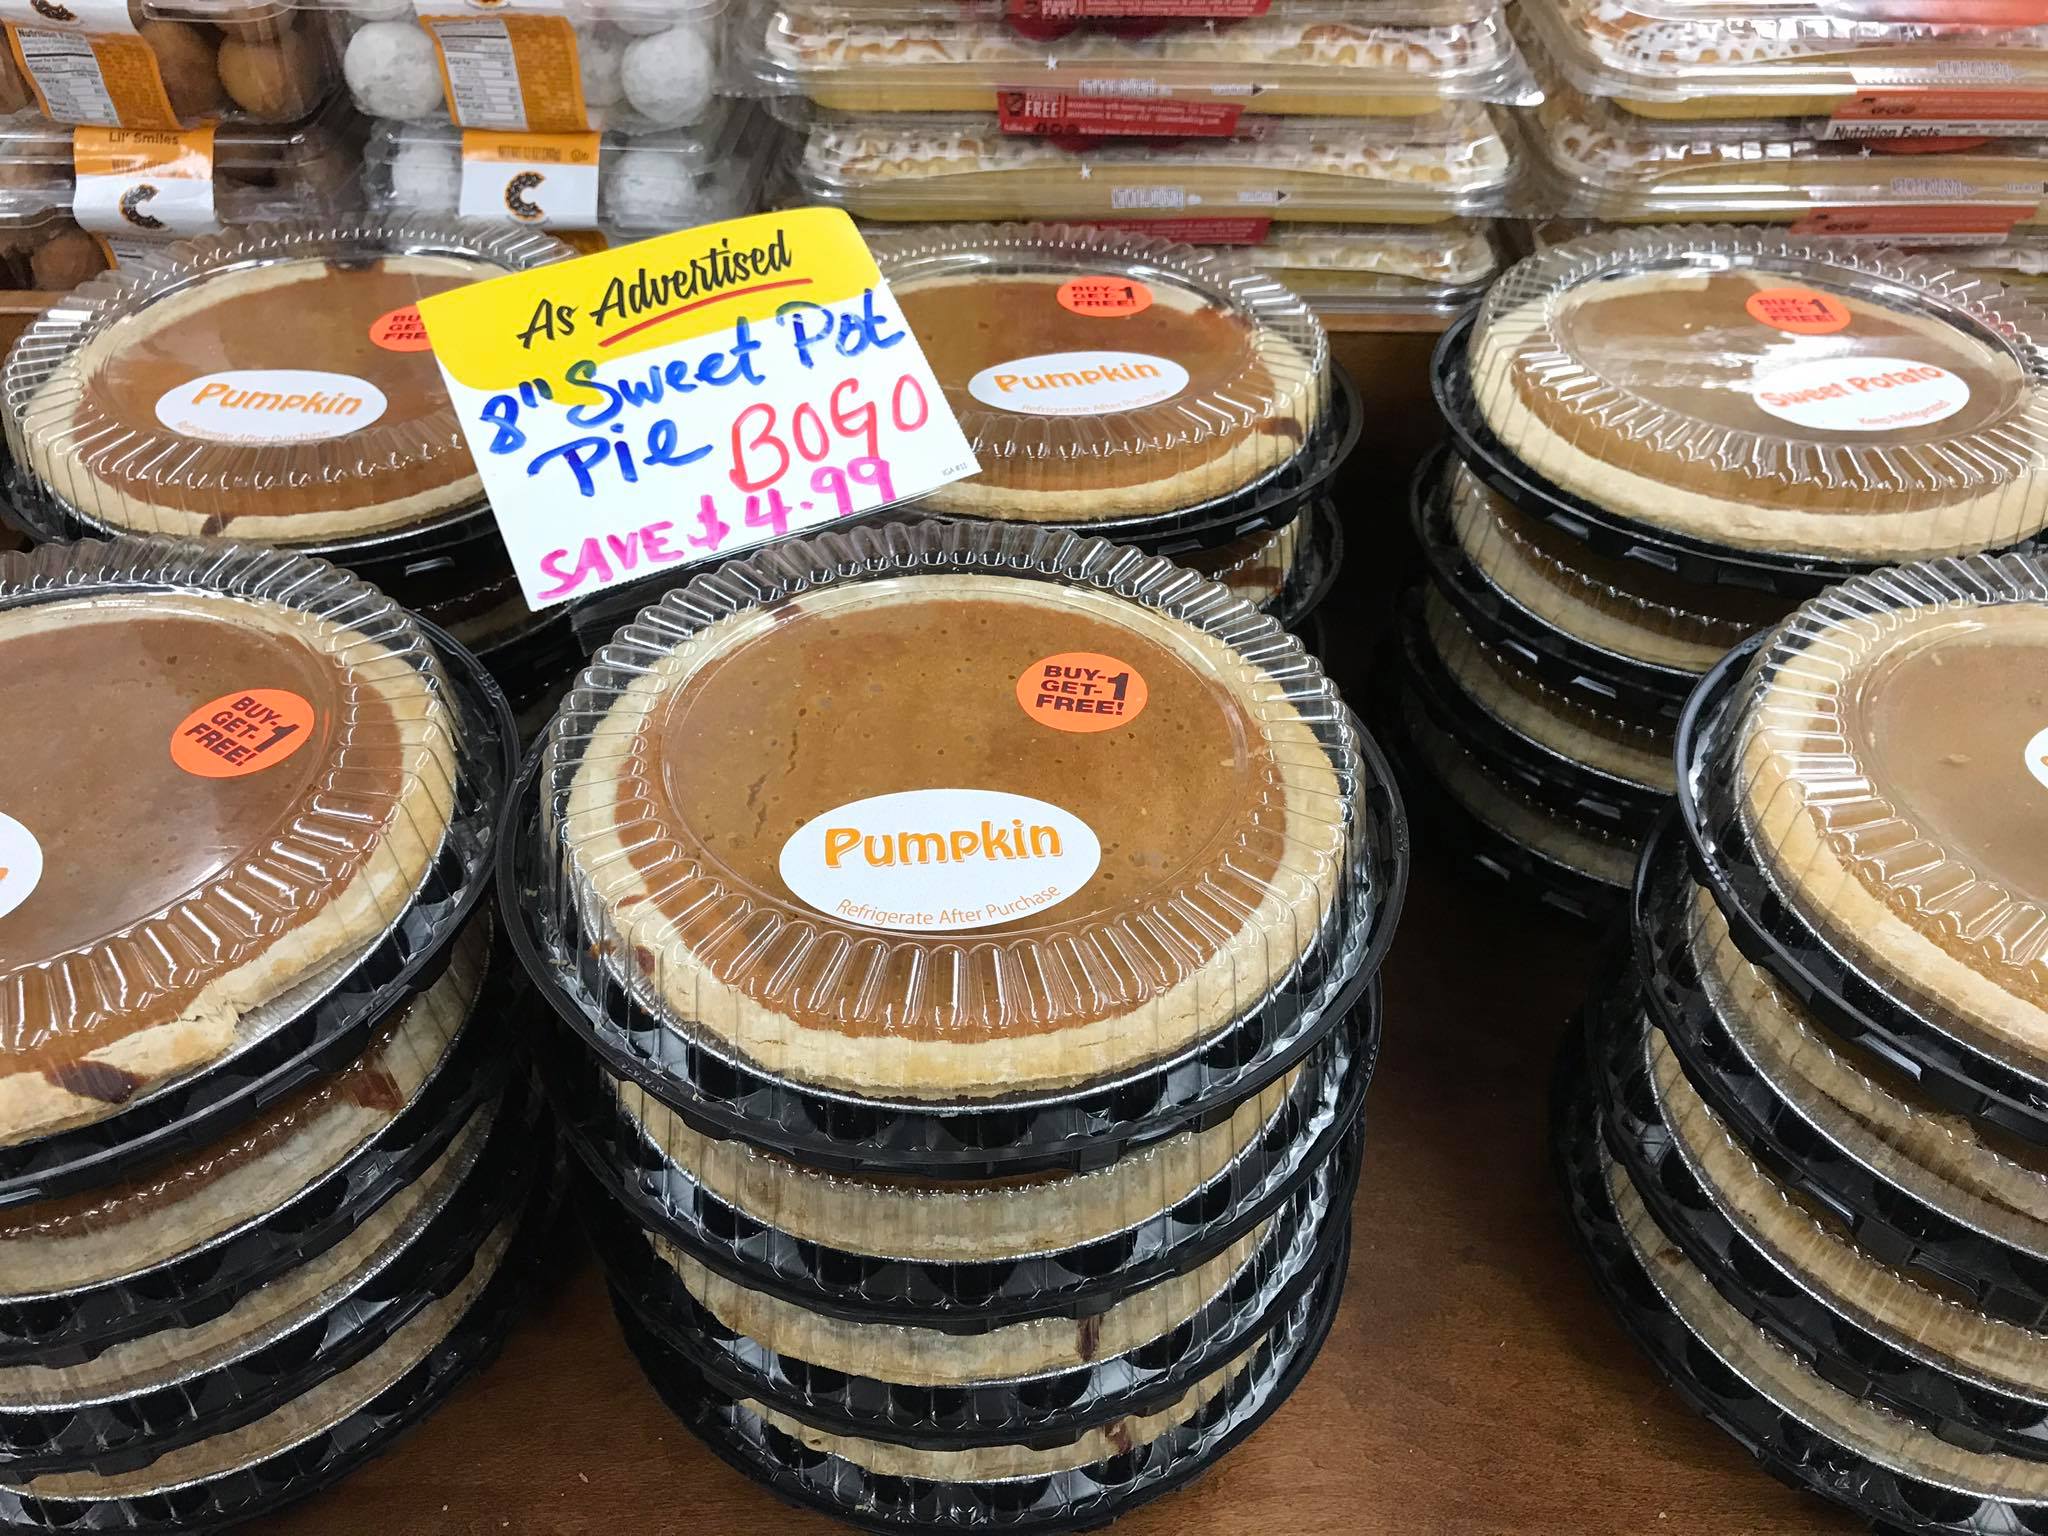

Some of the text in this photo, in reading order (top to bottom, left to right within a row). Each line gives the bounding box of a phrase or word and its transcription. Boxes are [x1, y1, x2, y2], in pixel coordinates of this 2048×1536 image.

[1024, 100, 1059, 118] FREE
[133, 131, 179, 145] Smiles
[1833, 125, 1899, 140] Nutrition
[1900, 126, 1942, 139] Facts
[517, 229, 793, 349] As Advertised
[566, 317, 766, 429] Sweet
[775, 289, 905, 369] Pot
[994, 363, 1162, 393] Pumpkin
[1760, 366, 1944, 407] Sweet Potato
[191, 383, 364, 416] Pumpkin
[527, 374, 929, 497] Pie BOGO
[537, 521, 684, 600] SAVE
[1041, 680, 1102, 696] GET-
[1043, 665, 1106, 680] BUY-
[1107, 672, 1129, 701] 1
[1036, 693, 1124, 715] FREE!
[184, 722, 258, 767] FREE!
[824, 818, 1063, 869] Pumpkin
[836, 885, 1061, 926] Refrigerate After Purchase
